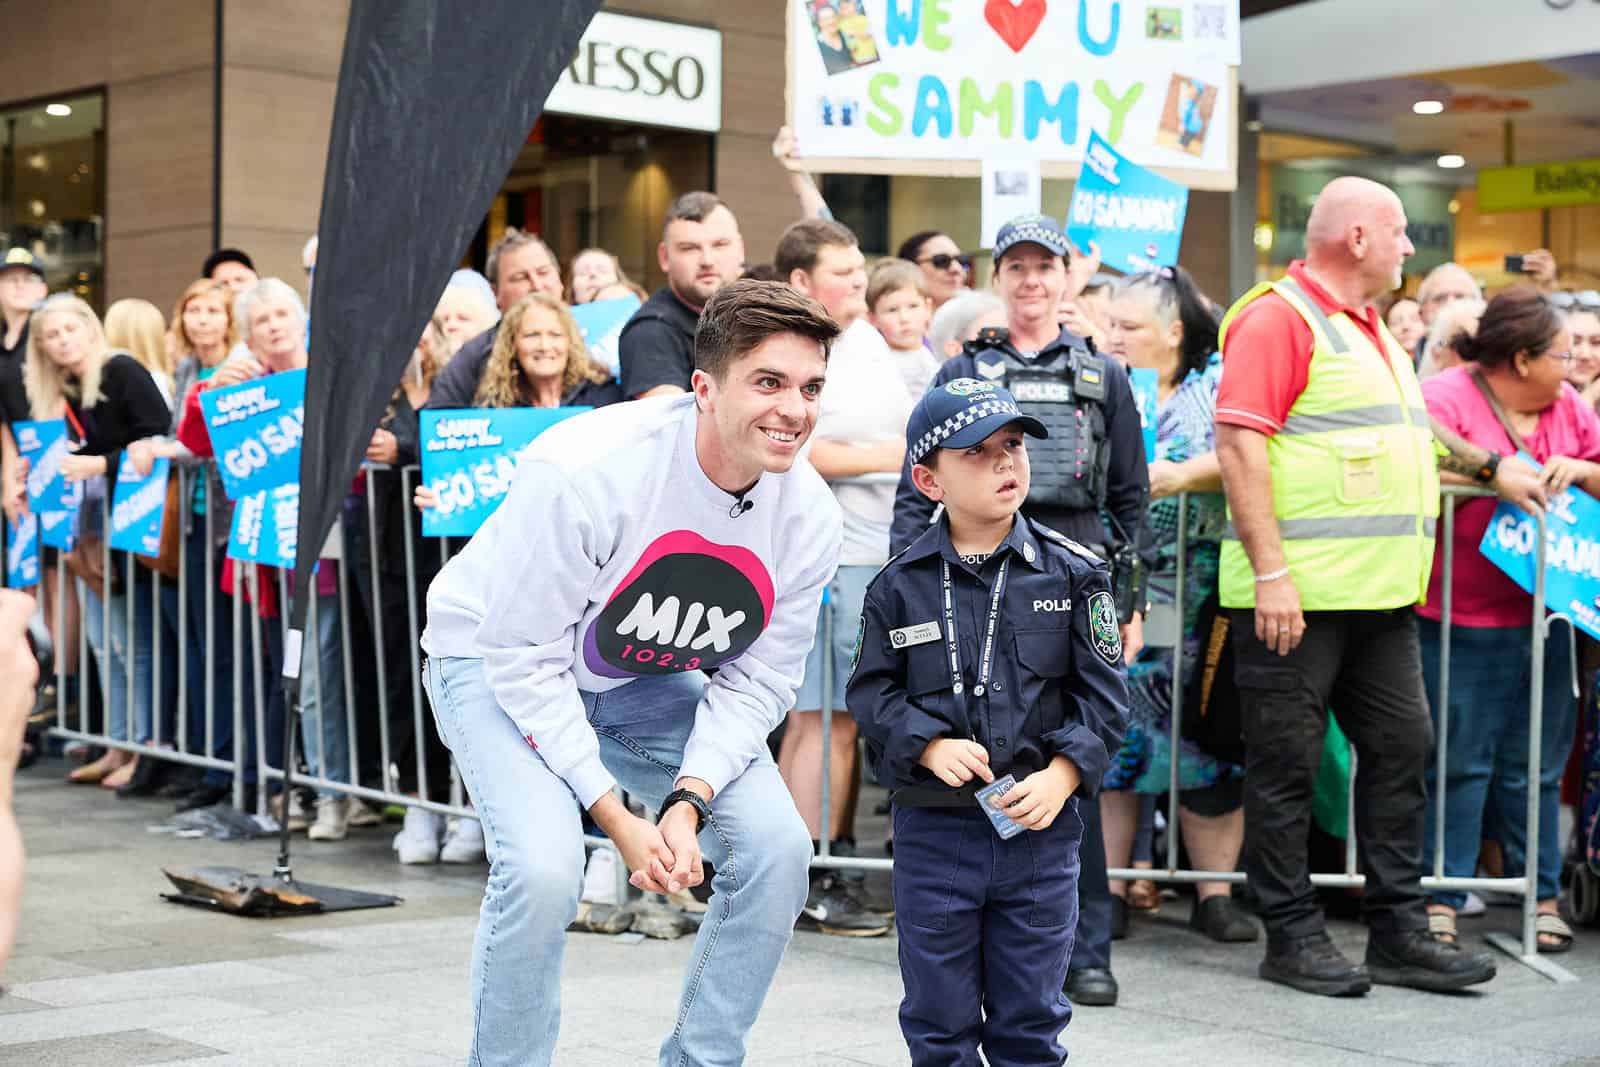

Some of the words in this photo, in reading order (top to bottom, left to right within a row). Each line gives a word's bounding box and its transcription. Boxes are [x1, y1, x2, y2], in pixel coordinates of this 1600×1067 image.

[885, 0, 953, 51] WE
[1077, 0, 1120, 56] U
[865, 72, 1145, 146] SAMMY
[1014, 382, 1069, 401] POLICE
[224, 438, 268, 478] GO
[432, 472, 475, 514] GO
[1498, 515, 1534, 555] GO
[616, 593, 746, 652] MIX
[619, 644, 701, 672] 102.3
